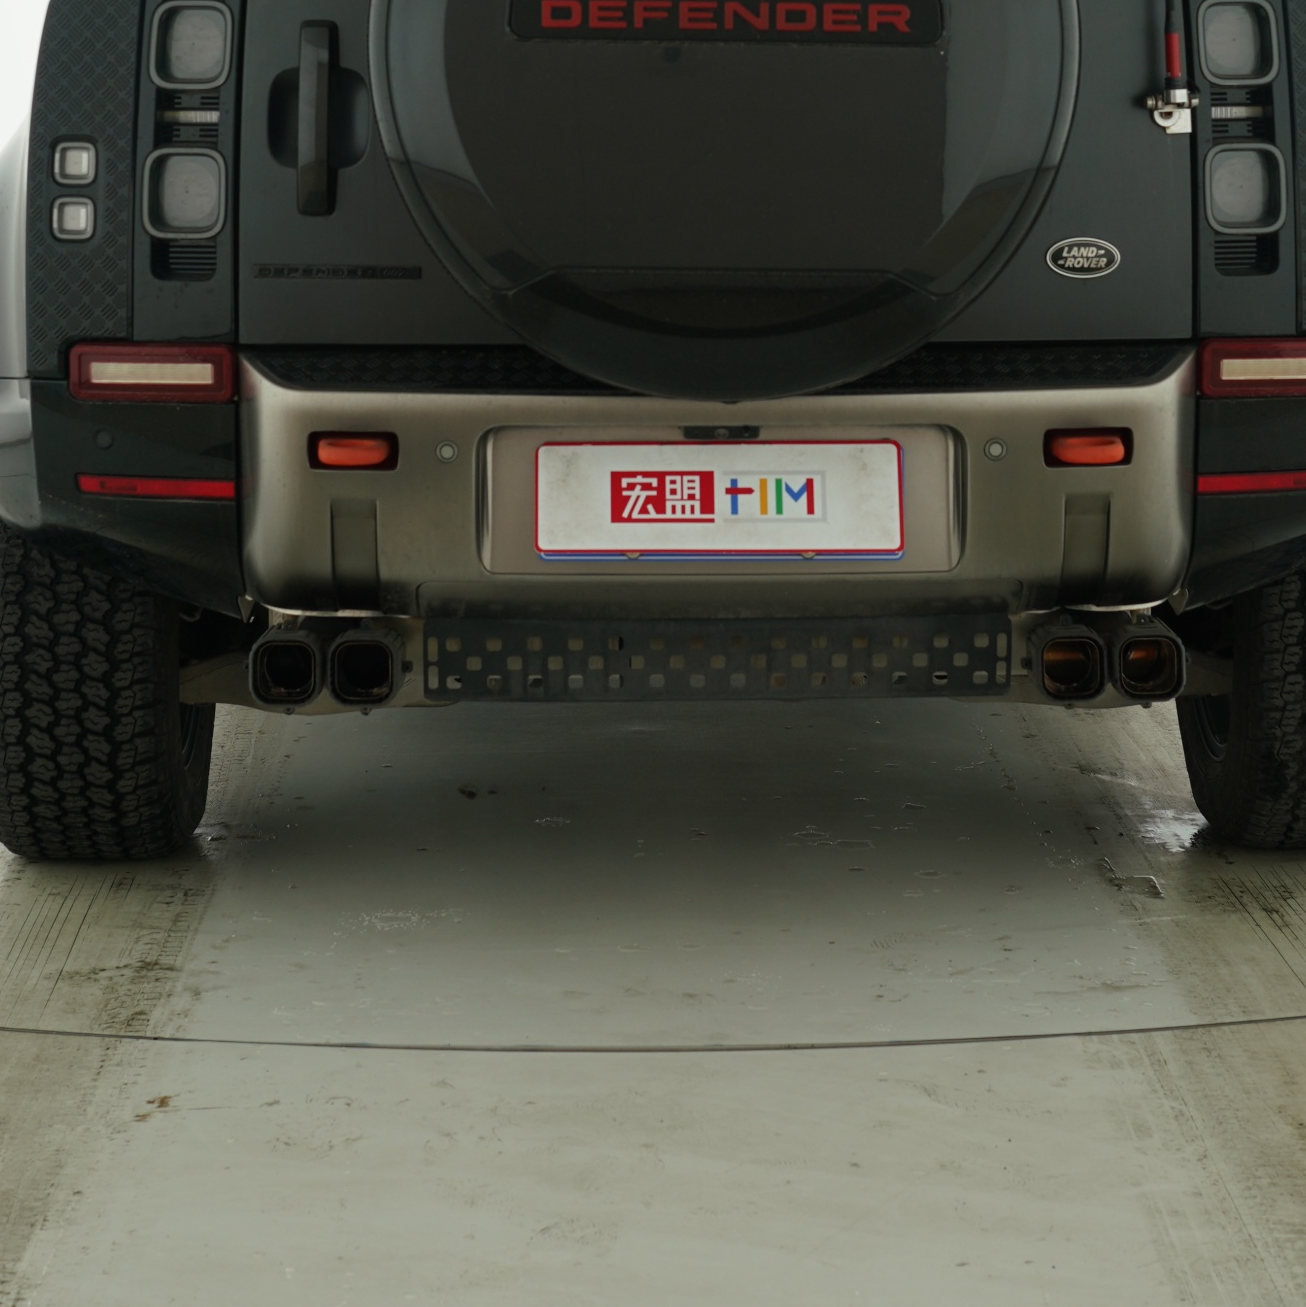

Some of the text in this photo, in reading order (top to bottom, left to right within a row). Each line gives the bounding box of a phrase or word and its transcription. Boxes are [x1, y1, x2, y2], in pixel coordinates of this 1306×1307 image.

[1062, 246, 1097, 257] LAND
[1064, 257, 1108, 268] ROVER
[620, 474, 715, 520] 宏盟
